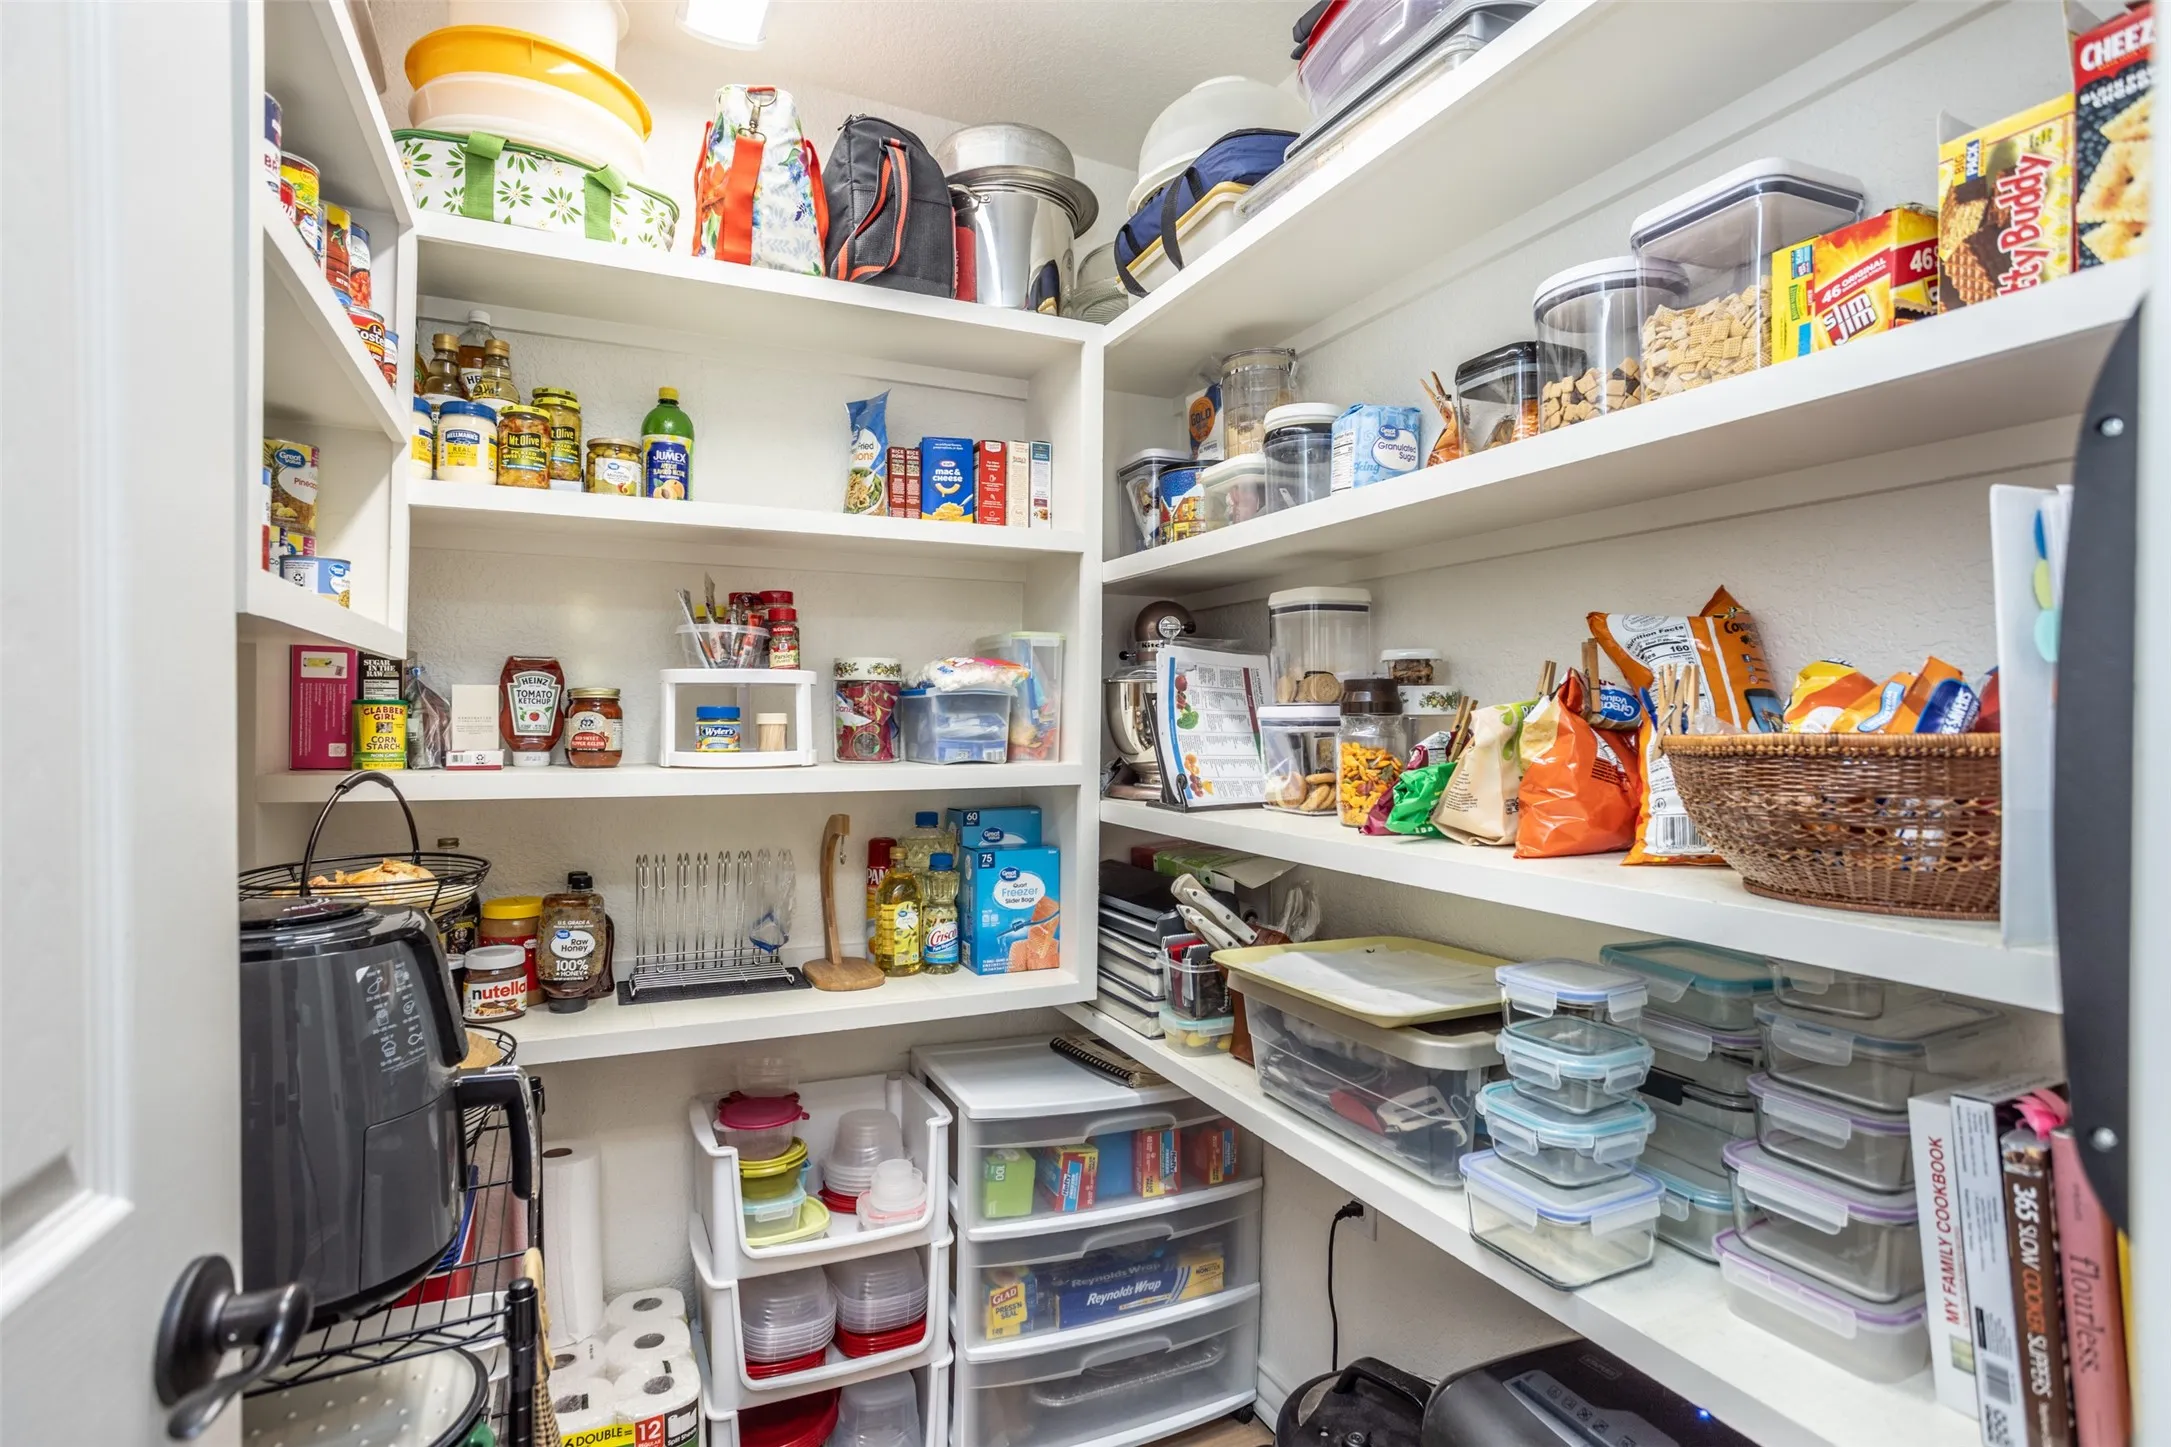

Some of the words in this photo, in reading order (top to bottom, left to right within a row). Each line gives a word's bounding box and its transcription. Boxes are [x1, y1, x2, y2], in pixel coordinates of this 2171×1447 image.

[1955, 153, 1965, 175] BIG
[1966, 142, 1979, 177] PACK
[2000, 155, 2053, 250] Buddy
[1910, 248, 1933, 272] 46
[1821, 285, 1842, 304] 46
[1842, 257, 1887, 288] ORIGINAL
[2000, 250, 2050, 295] tty
[373, 325, 382, 335] La
[1191, 408, 1211, 426] GOLD
[509, 435, 519, 445] Mt.
[520, 434, 540, 447] Olive
[556, 427, 574, 440] Olive
[279, 451, 301, 461] Great
[653, 450, 686, 463] JUMEX
[954, 468, 961, 476] &
[1659, 625, 1684, 633] Facts
[1670, 645, 1690, 653] 160
[521, 676, 549, 686] HEINZ
[516, 690, 553, 699] TOMATO
[518, 697, 551, 705] KETCHUP
[363, 706, 405, 716] CLABBER
[703, 727, 735, 736] Wyler's
[366, 743, 402, 751] STARCH
[966, 812, 978, 821] 60
[981, 854, 993, 863] 75
[1001, 887, 1038, 898] Freezer
[930, 928, 957, 947] Crisco
[556, 960, 588, 971] 100%
[472, 981, 527, 1000] nutella
[995, 1165, 1005, 1181] 100
[1062, 1174, 1071, 1195] Hefty
[1928, 1136, 1951, 1234] COOKBOOK
[2013, 1183, 2040, 1224] 365
[2018, 1223, 2040, 1271] SLOW
[1938, 1237, 1957, 1294] FAMILY
[1072, 1269, 1128, 1287] Reynolds
[1128, 1263, 1161, 1275] Wrap
[992, 1288, 1017, 1305] GLAD
[1087, 1286, 1133, 1306] Reynolds
[1134, 1279, 1162, 1294] Wrap
[2022, 1270, 2045, 1333] COOKER
[1001, 1311, 1018, 1320] SEAL
[1943, 1301, 1960, 1325] MY
[2070, 1254, 2105, 1374] flourless
[2027, 1332, 2052, 1398] SUPPERS
[576, 1427, 623, 1446] DOUBLE
[639, 1420, 661, 1441] 12
